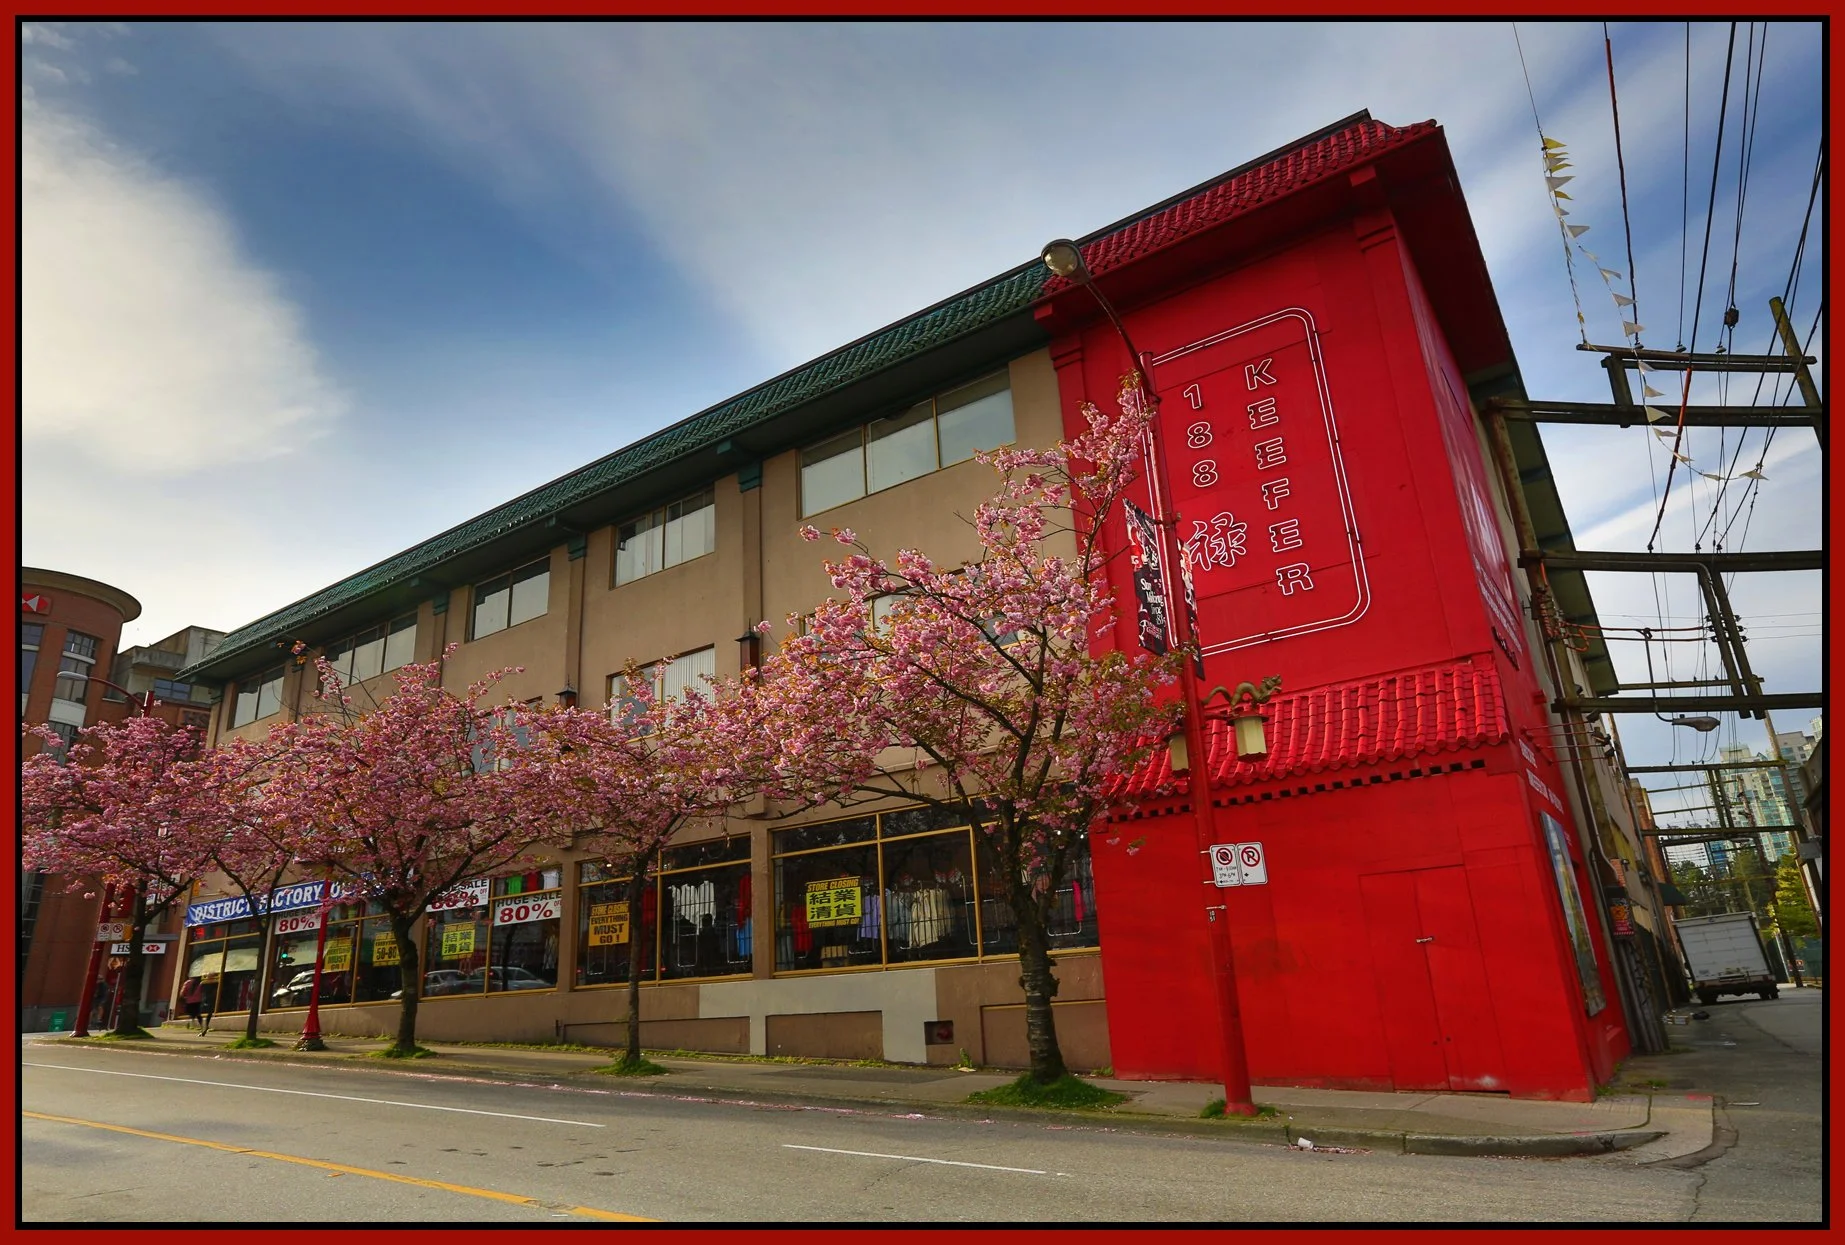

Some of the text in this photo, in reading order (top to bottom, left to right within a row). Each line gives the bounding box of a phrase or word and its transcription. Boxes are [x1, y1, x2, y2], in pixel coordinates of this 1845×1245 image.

[1183, 383, 1218, 488] 188
[1244, 356, 1315, 597] KEEFER
[807, 878, 859, 892] STORE CLOSING
[497, 892, 562, 907] HUGE SALE
[809, 889, 856, 906] 結業
[194, 898, 251, 922] DISTRICT
[499, 902, 554, 923] 80%
[810, 903, 857, 919] 清貨
[278, 916, 315, 932] 80%
[591, 914, 629, 925] EVERYTHING
[836, 918, 850, 926] MUST
[594, 923, 625, 935] MUST
